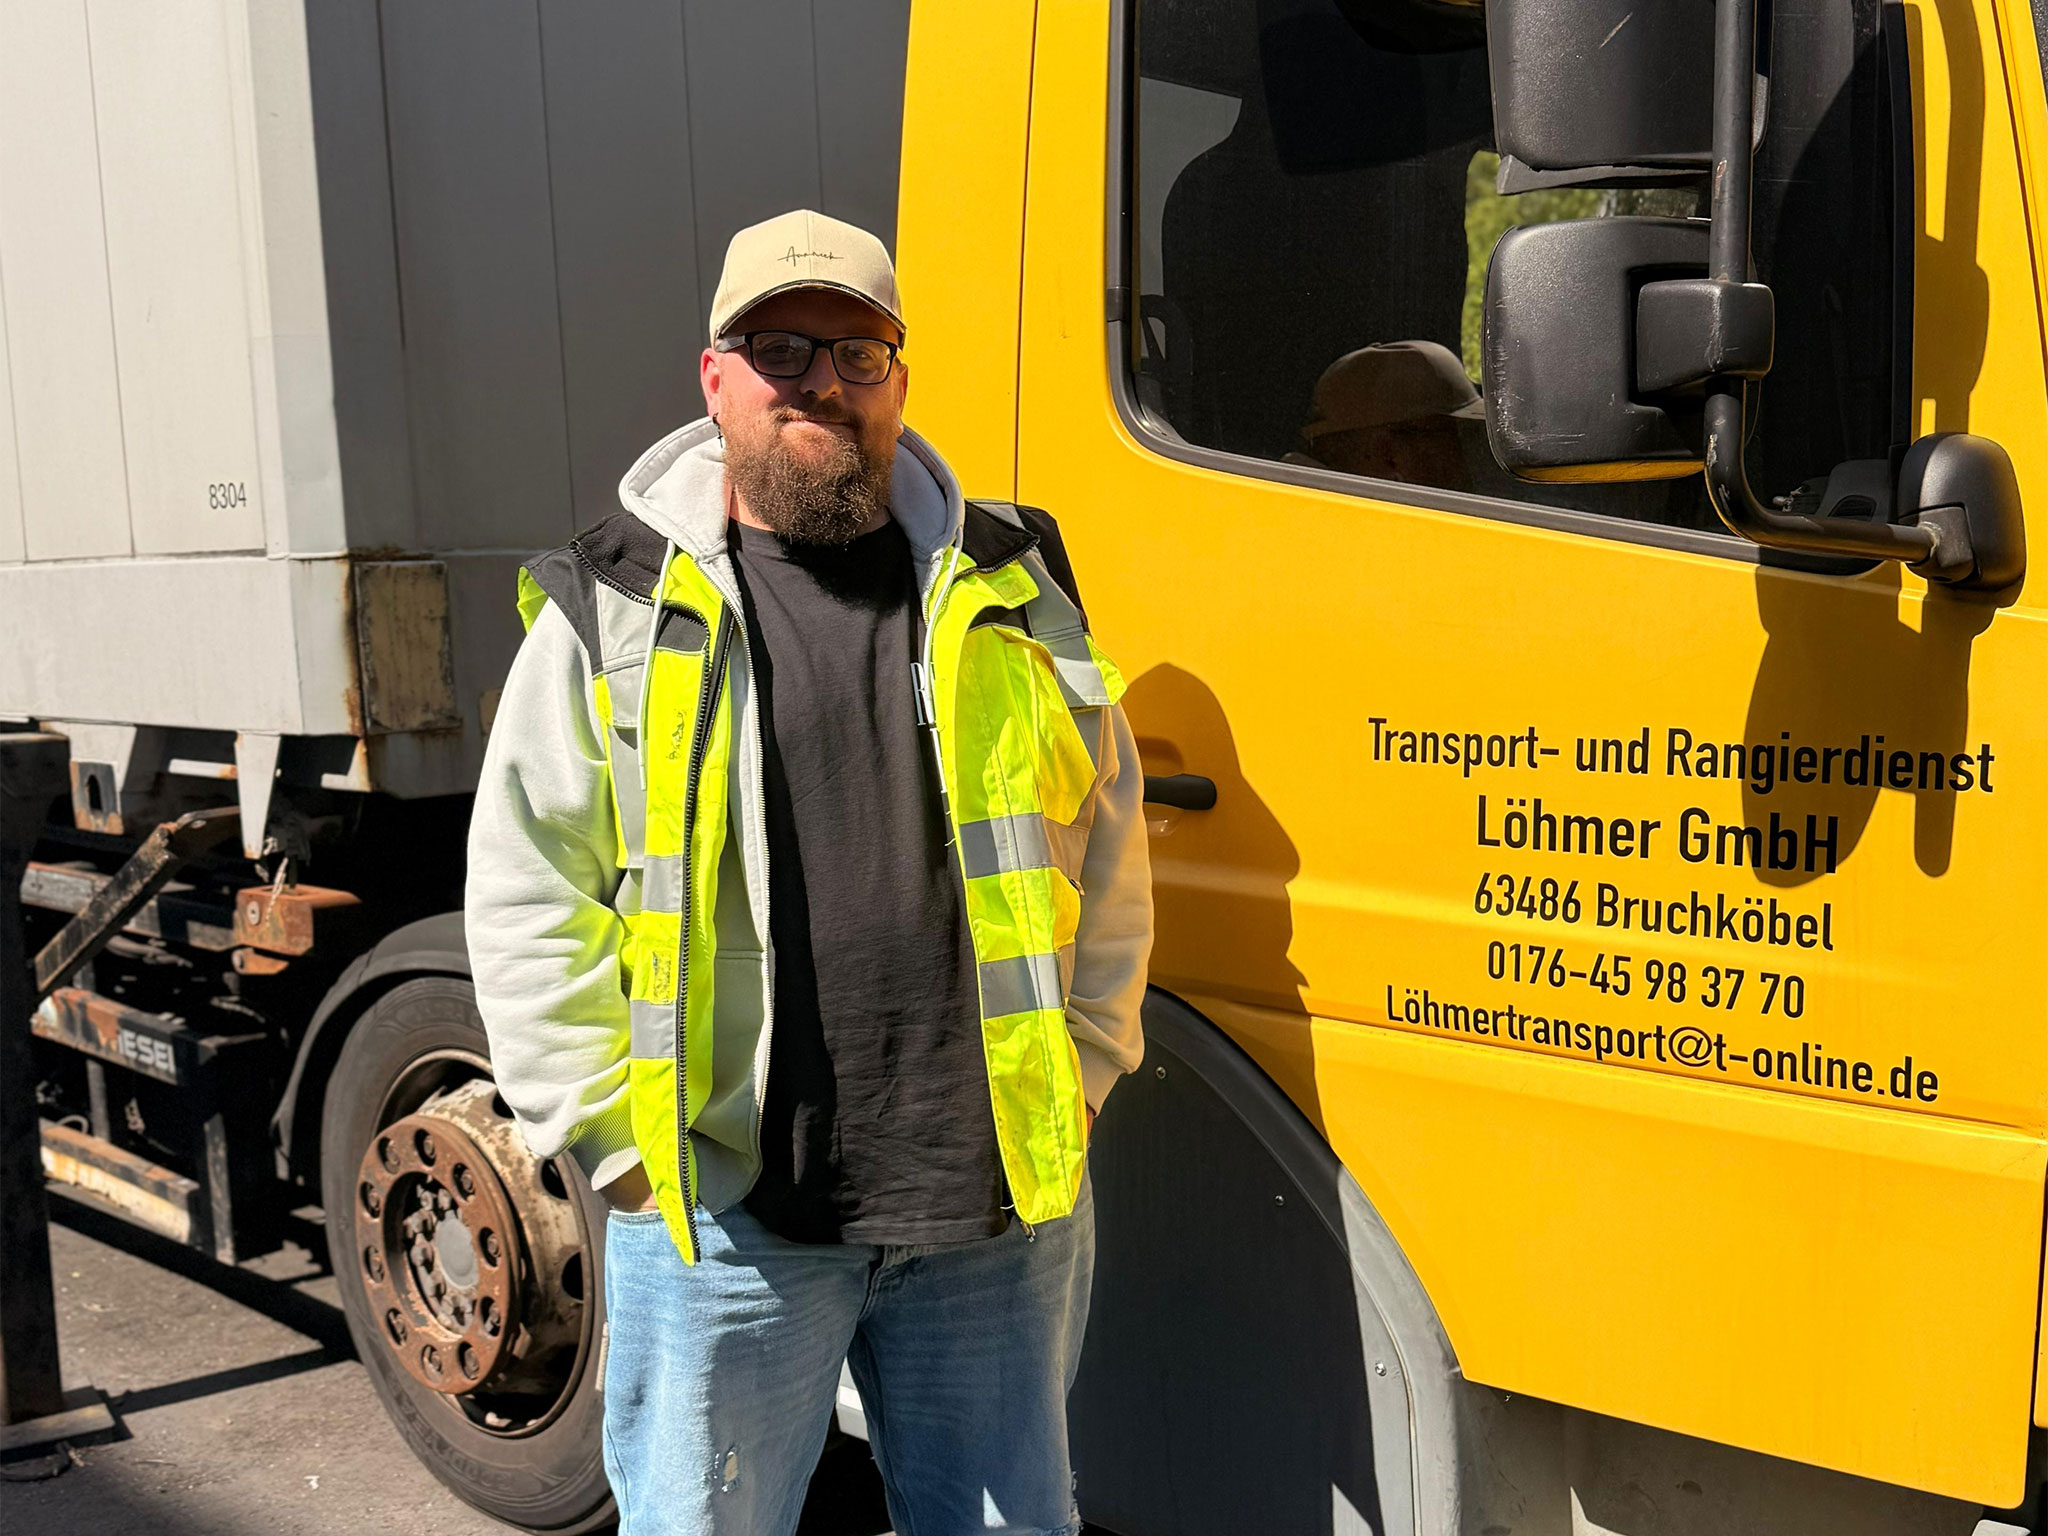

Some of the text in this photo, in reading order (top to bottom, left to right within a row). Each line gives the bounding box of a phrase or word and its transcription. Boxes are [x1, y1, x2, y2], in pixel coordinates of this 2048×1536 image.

[208, 482, 247, 510] 8304
[1368, 717, 1995, 795] Transport- und Rangierdienst
[1476, 794, 1839, 874] Löhmer GmbH
[1474, 872, 1834, 951] 63486 Bruchköbel
[1487, 940, 1805, 1018] 0176-45 98 37 70
[1386, 984, 1939, 1102] Löhmertransport@t-online.de
